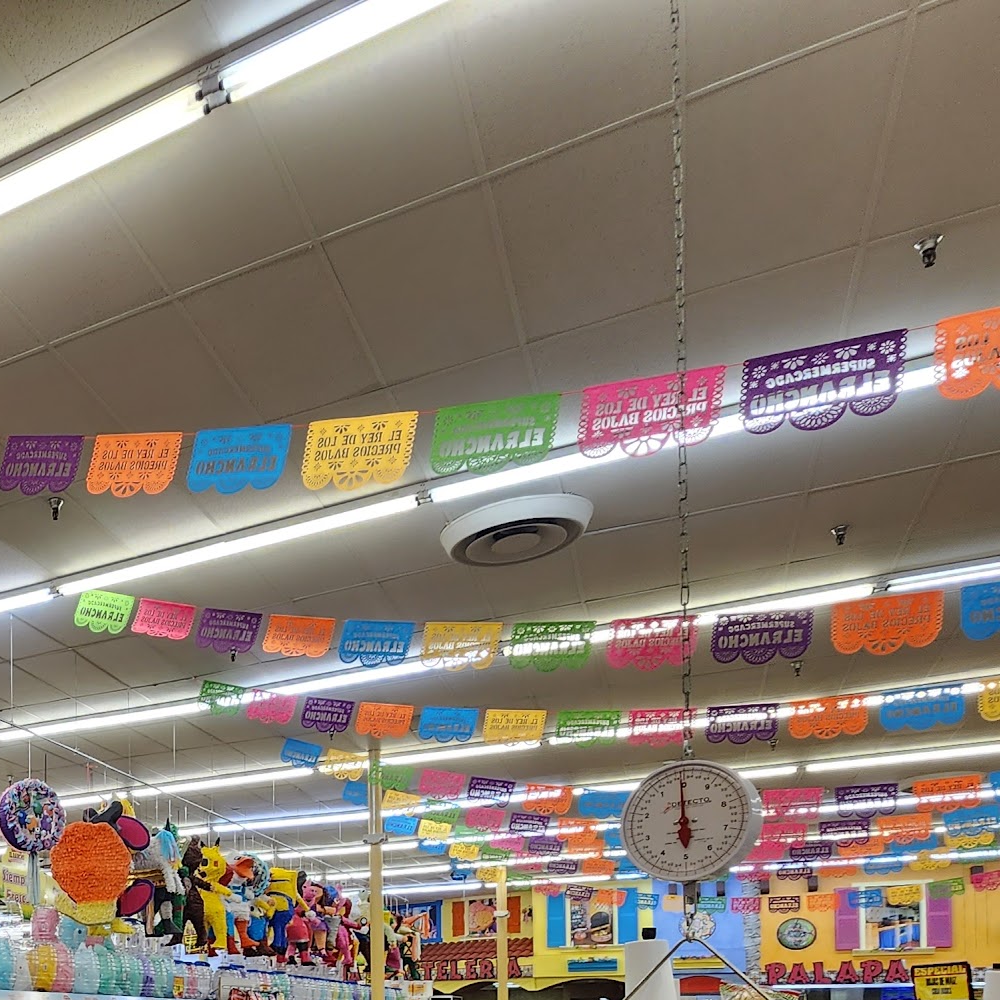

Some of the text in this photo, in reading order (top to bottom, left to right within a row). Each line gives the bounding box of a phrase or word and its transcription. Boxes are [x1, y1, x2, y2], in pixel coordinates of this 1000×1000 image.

[2, 868, 26, 886] Siemp
[421, 957, 521, 980] TELERA
[765, 959, 910, 986] PALAPA
[914, 965, 967, 976] ESPECIAL
